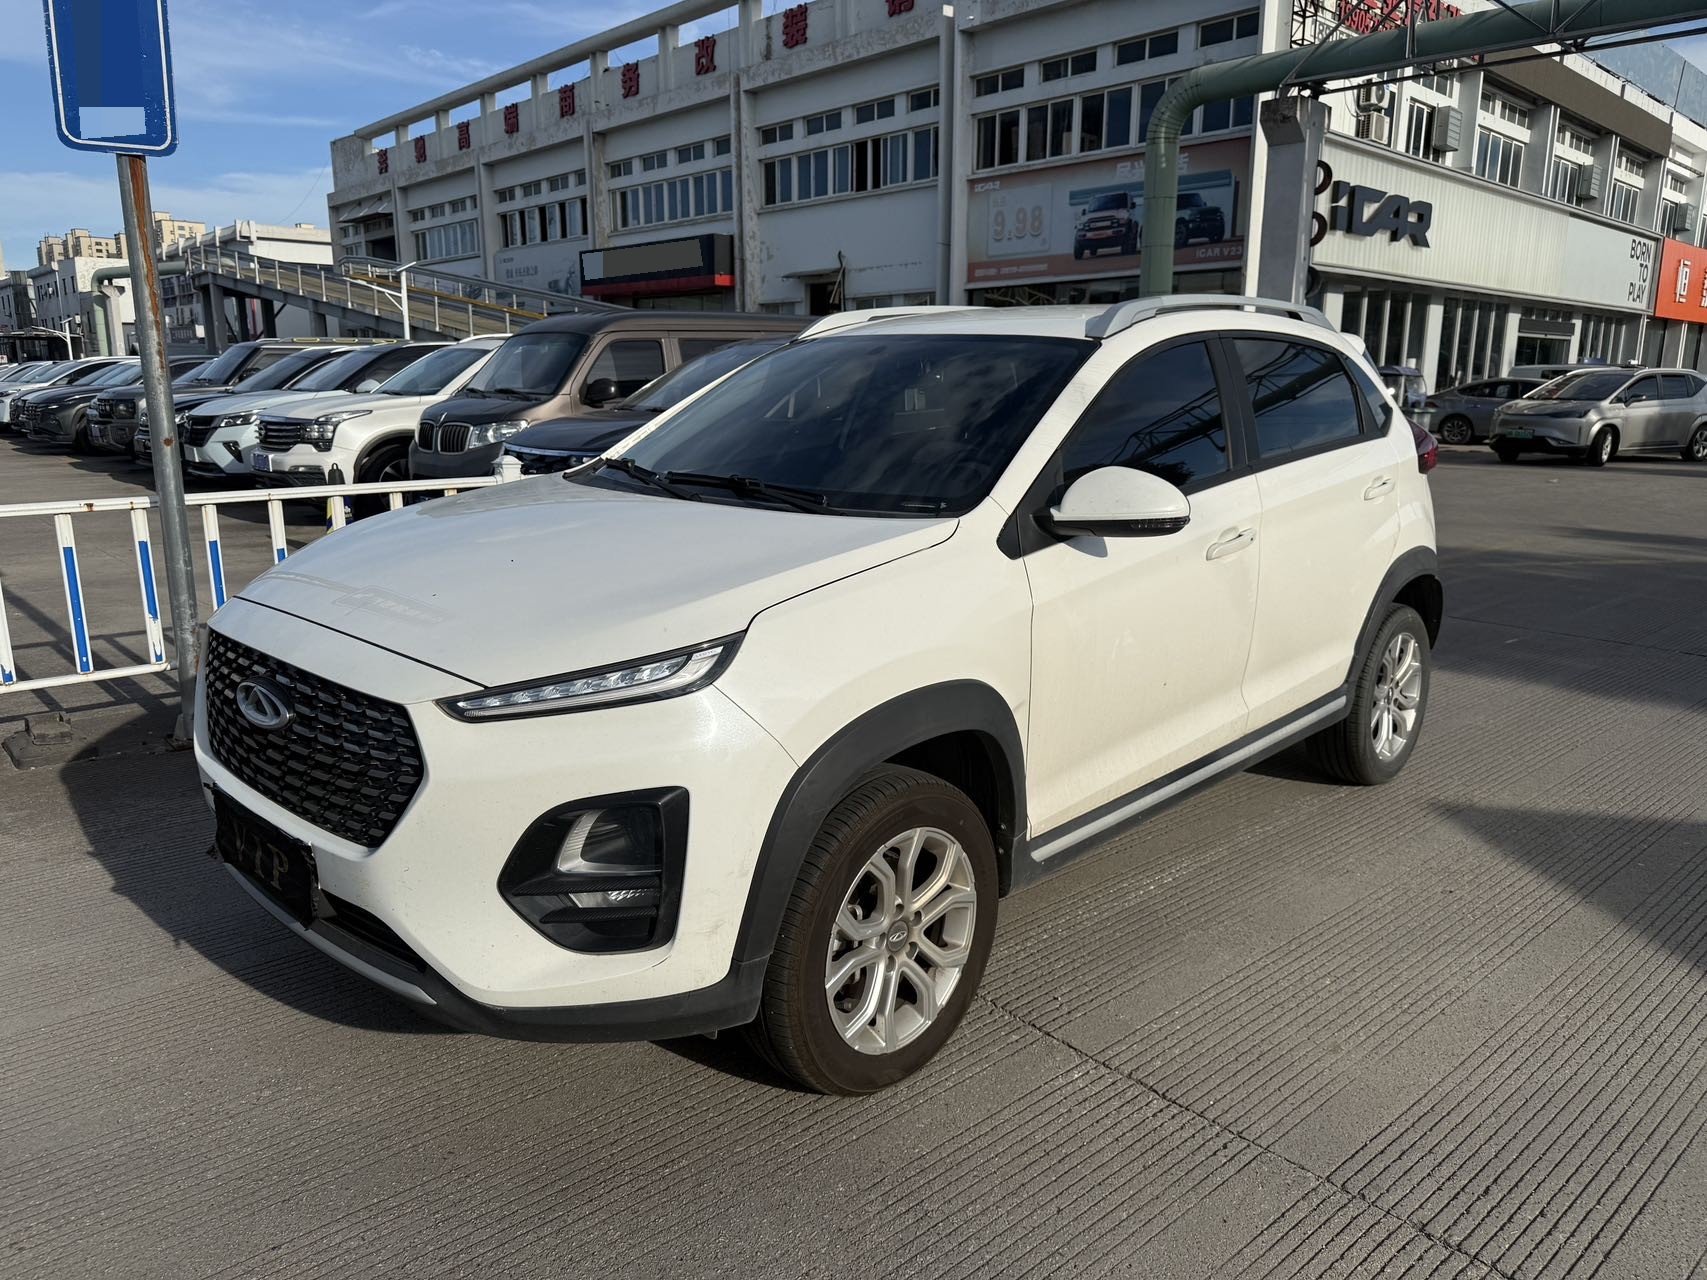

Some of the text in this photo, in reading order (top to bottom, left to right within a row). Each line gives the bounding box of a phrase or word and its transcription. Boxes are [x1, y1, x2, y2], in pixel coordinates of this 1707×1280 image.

[992, 206, 1043, 241] 9.98
[1630, 239, 1653, 263] BORN
[1639, 263, 1649, 283] TO
[1628, 281, 1647, 304] PLAY
[230, 815, 289, 892] VIP
